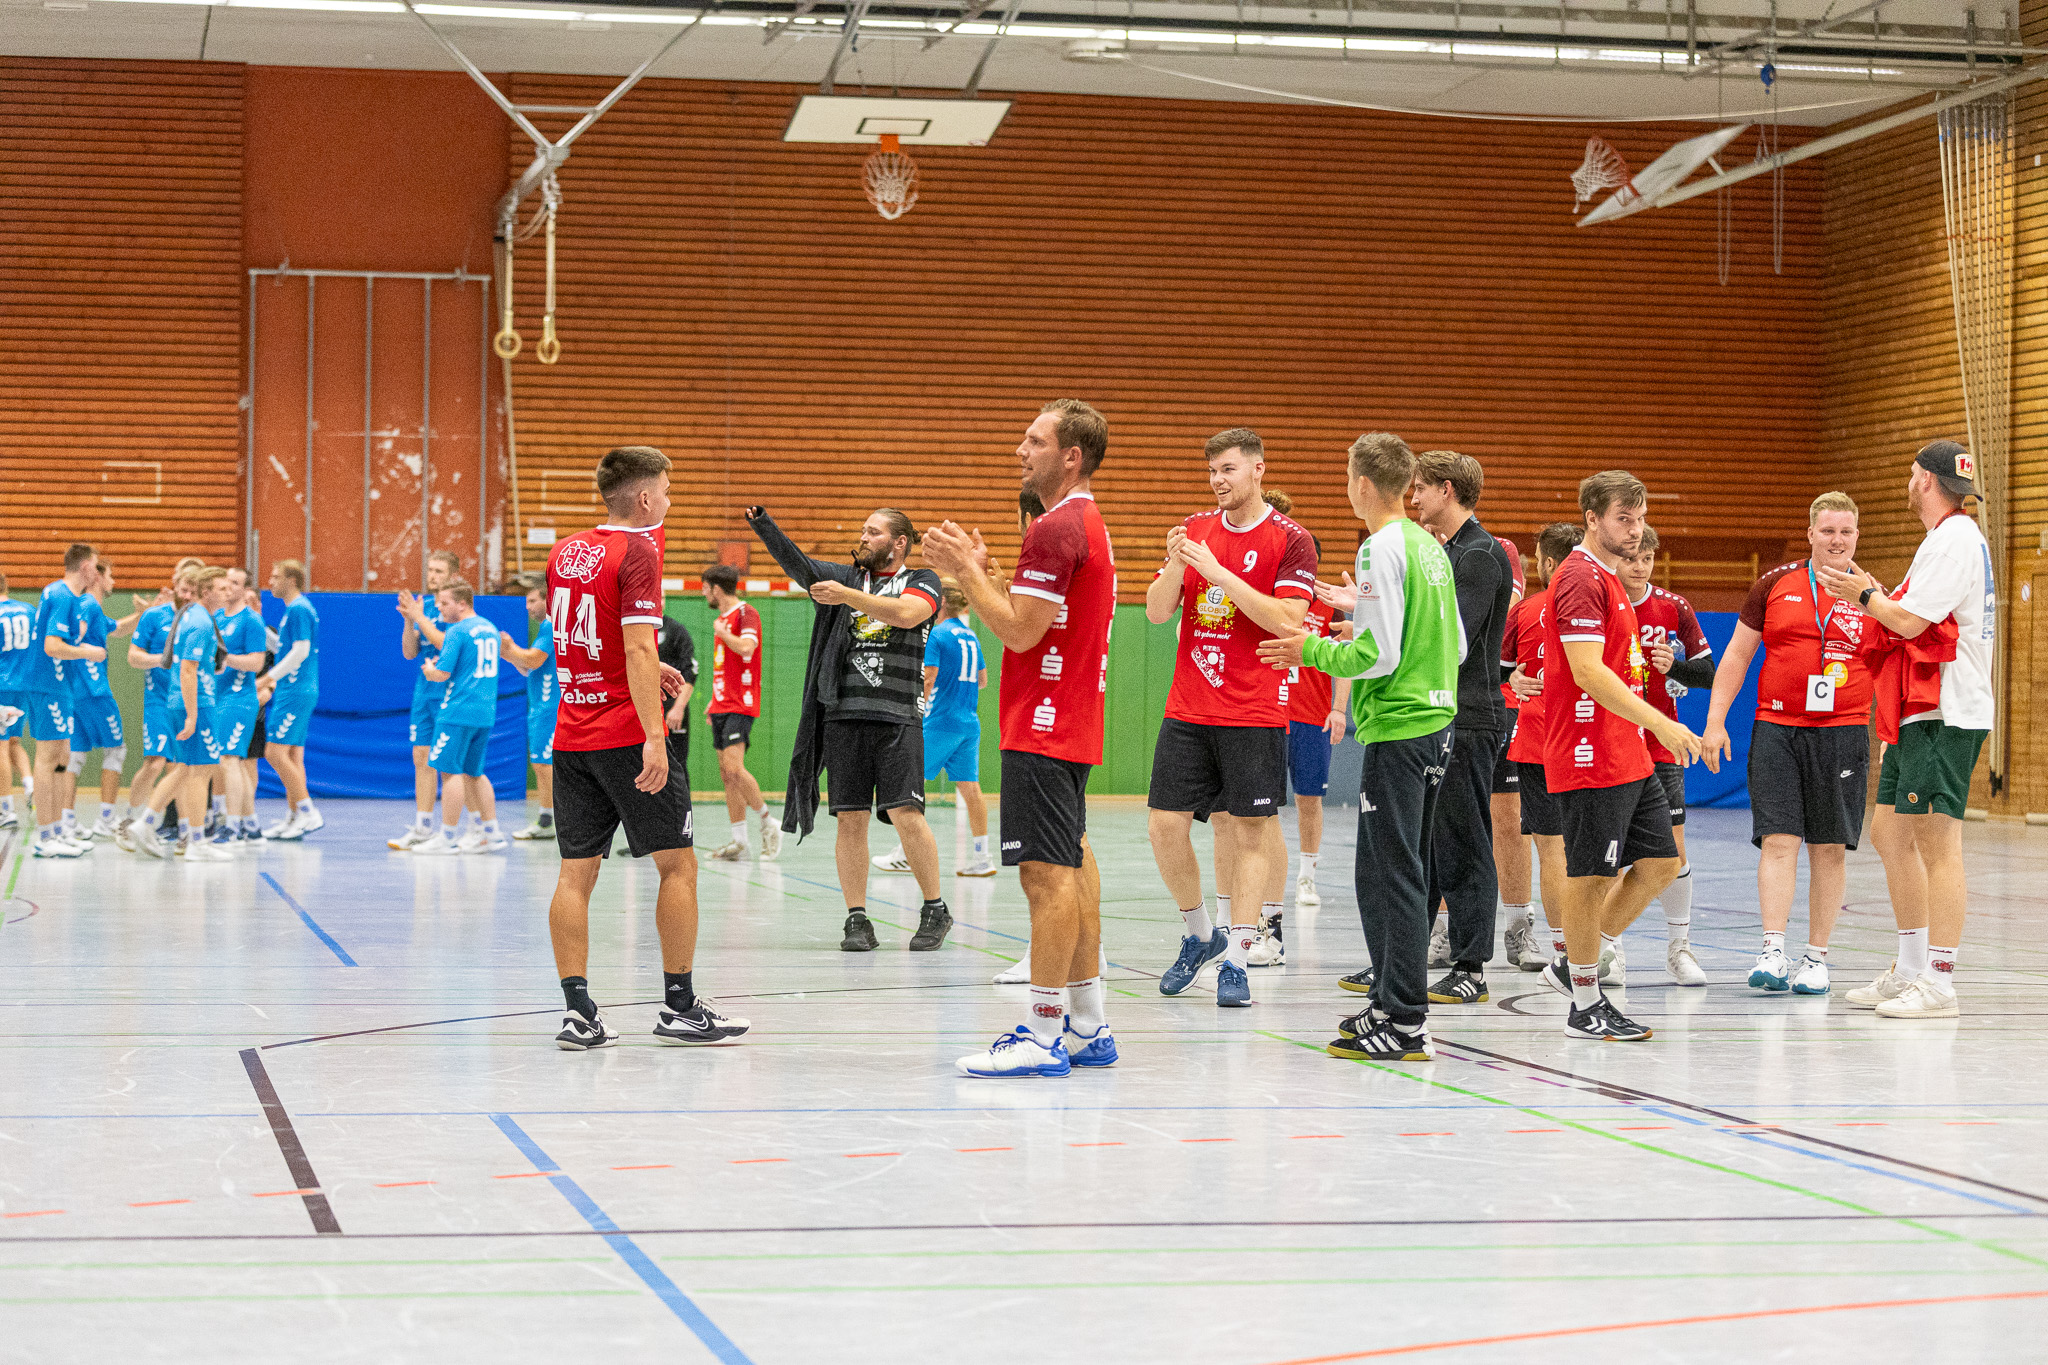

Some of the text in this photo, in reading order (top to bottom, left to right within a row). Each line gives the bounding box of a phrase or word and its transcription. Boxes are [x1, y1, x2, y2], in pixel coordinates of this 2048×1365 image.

[1243, 549, 1258, 572] 9
[1784, 594, 1802, 602] JAKO
[1198, 604, 1228, 615] GLOBUS
[1834, 606, 1864, 617] Weber
[552, 586, 602, 661] 44
[1640, 625, 1668, 648] 22
[473, 637, 498, 679] 19
[957, 638, 978, 683] 11
[1814, 681, 1829, 699] C
[1771, 699, 1784, 711] SH
[1031, 723, 1054, 733] nispa.de
[157, 733, 168, 753] 7
[1253, 797, 1271, 806] JAKO
[682, 810, 692, 839] 4
[1001, 840, 1022, 851] JAKO
[1604, 839, 1618, 867] 4
